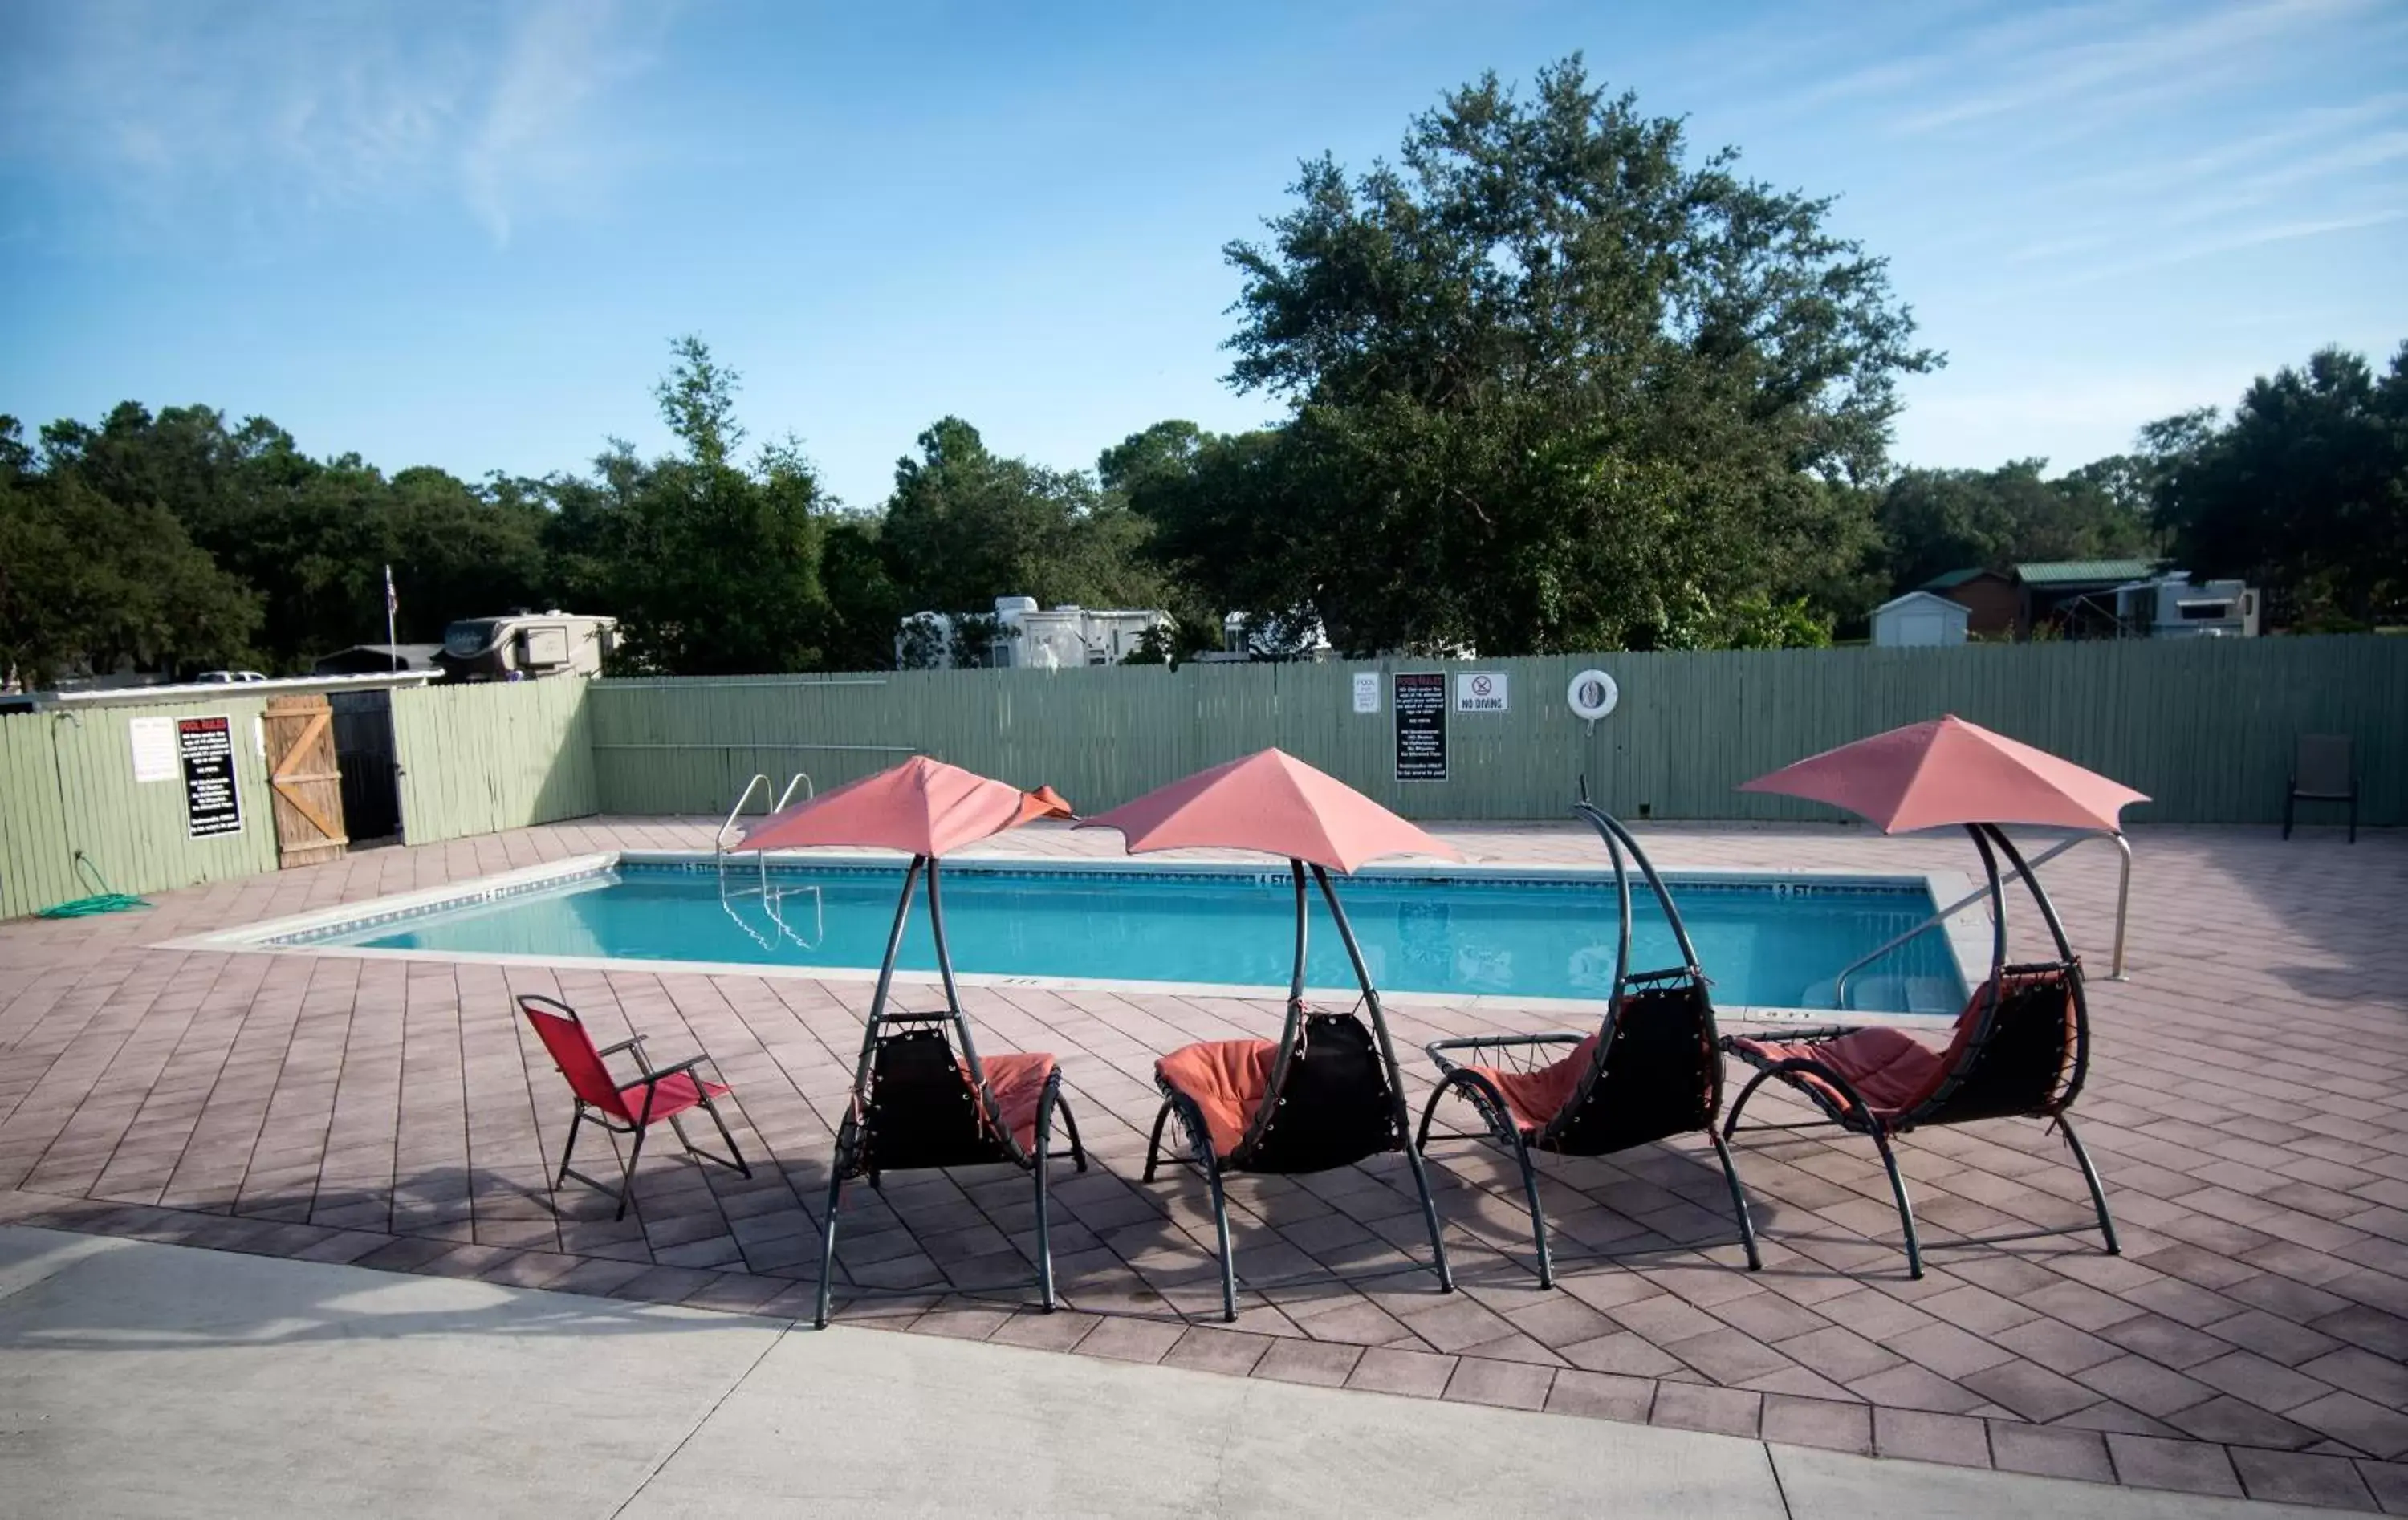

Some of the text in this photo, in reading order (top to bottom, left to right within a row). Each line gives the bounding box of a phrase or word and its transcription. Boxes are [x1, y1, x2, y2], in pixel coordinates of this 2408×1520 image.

[1462, 698, 1502, 708] NO DIVING
[1271, 874, 1285, 886] FT
[1793, 884, 1809, 896] FT
